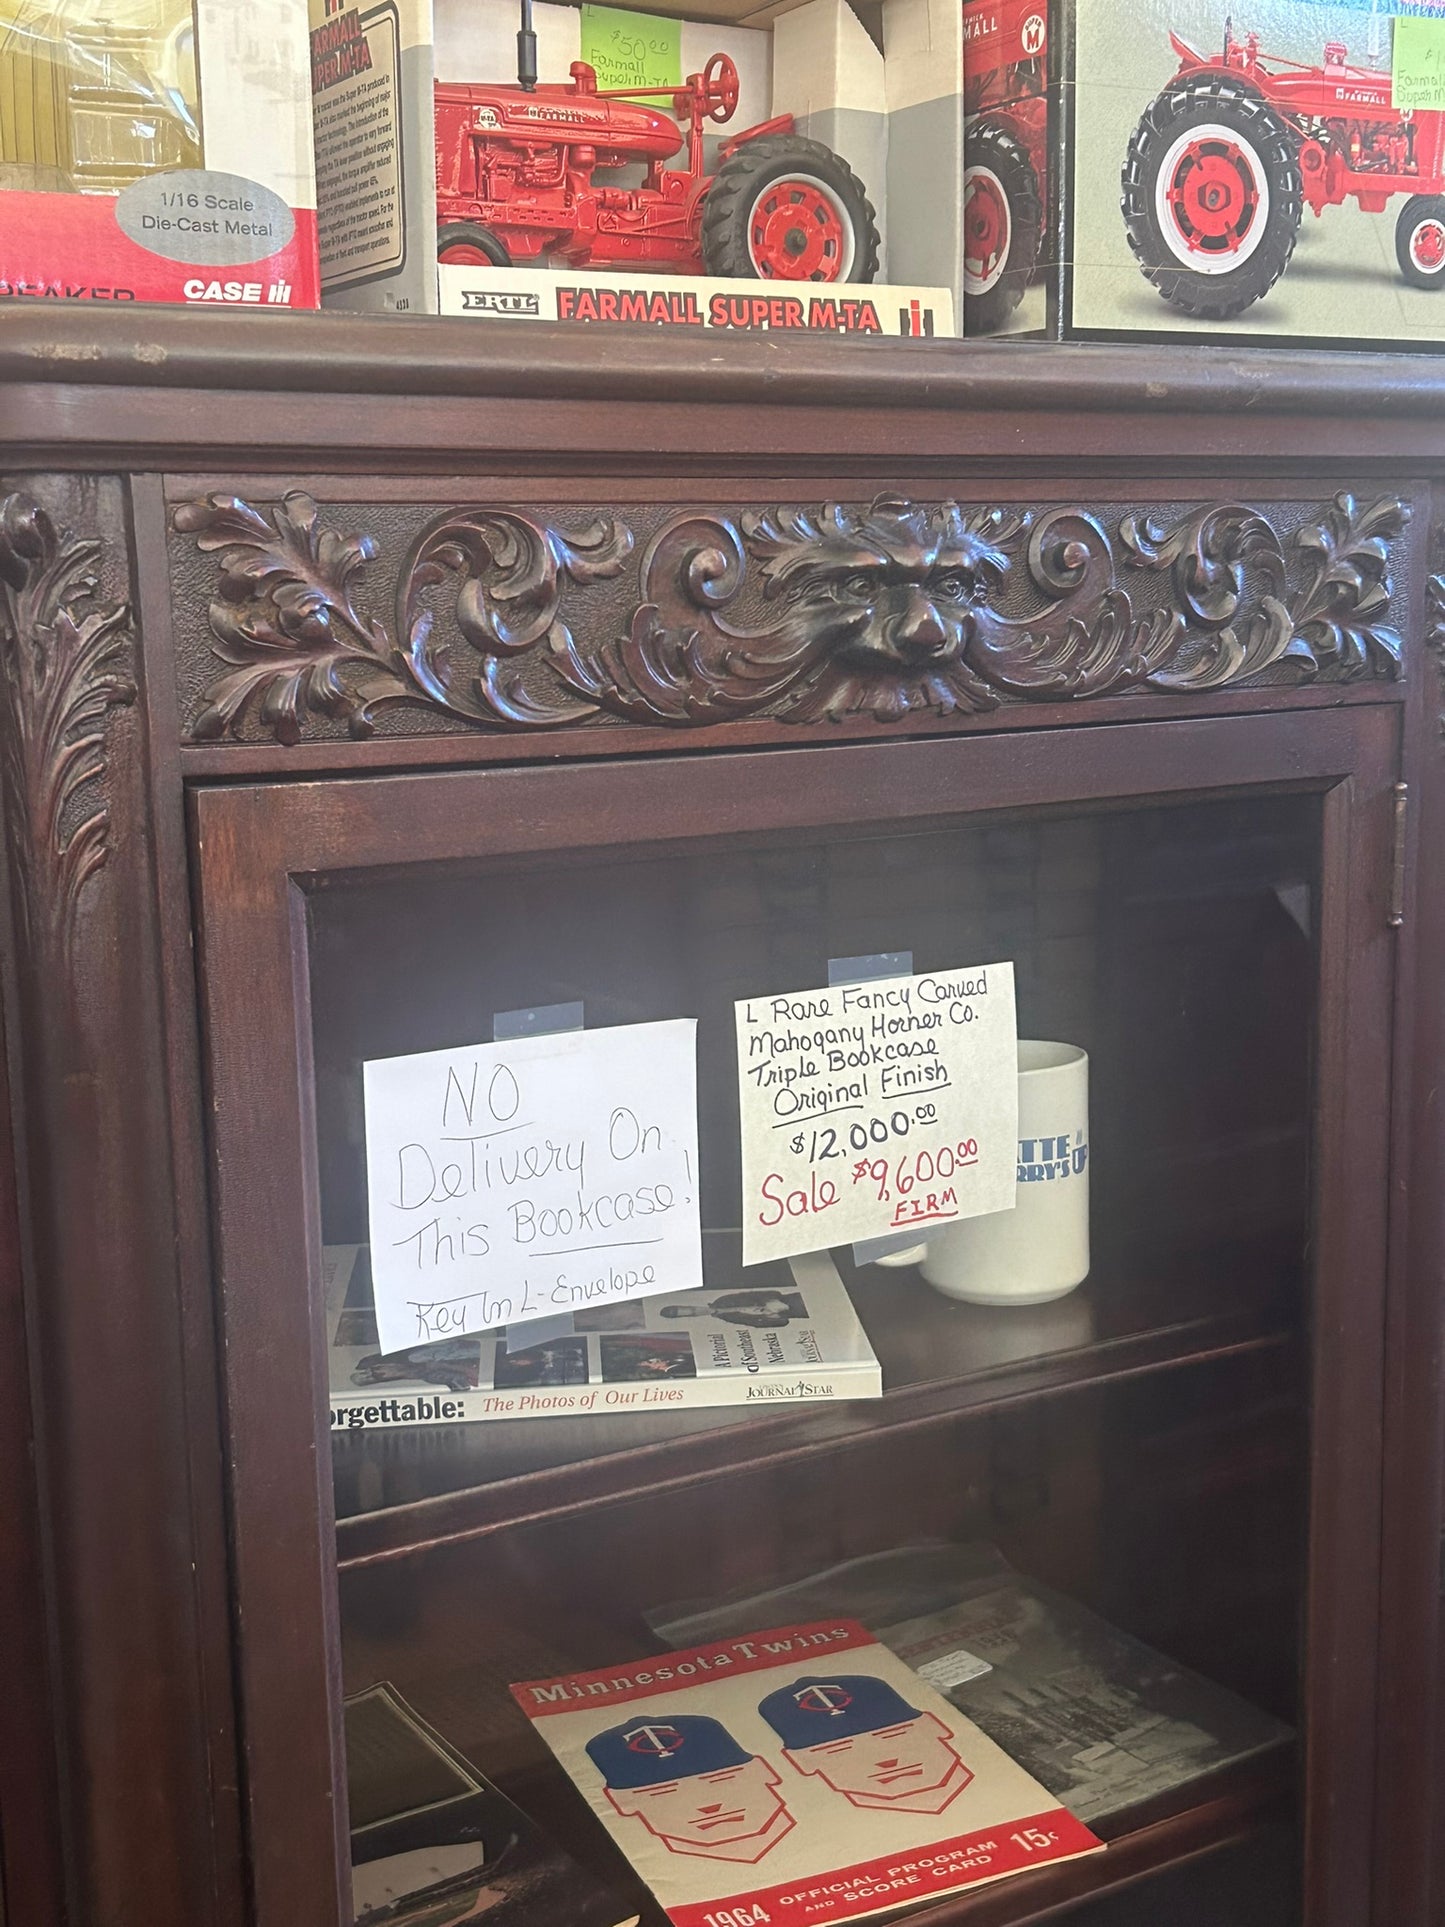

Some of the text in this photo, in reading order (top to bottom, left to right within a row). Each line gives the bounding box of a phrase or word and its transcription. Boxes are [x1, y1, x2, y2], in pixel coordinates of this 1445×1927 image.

[1026, 29, 1041, 51] M
[591, 48, 645, 74] Farmall
[1345, 92, 1386, 105] FARMALL
[161, 192, 255, 212] 1/16 Scale
[141, 214, 273, 237] Die-Cast Metal
[183, 279, 262, 303] CASE
[465, 293, 537, 312] ERTL
[558, 289, 702, 325] FARMALL
[711, 295, 804, 328] SUPER
[810, 301, 881, 332] M-TA
[746, 970, 988, 1024] L Rare Fancy Carved
[749, 1001, 979, 1059] Mahogany Horner Co.
[747, 1038, 940, 1088] Triple Bookcase
[442, 1061, 520, 1127] NO
[773, 1059, 949, 1117] Original Finish
[388, 1106, 662, 1210] Delivery On
[1016, 1133, 1070, 1163] TTE
[759, 1170, 841, 1227] Sale
[893, 1186, 959, 1221] FIRM
[392, 1216, 490, 1269] This
[414, 1301, 467, 1341] Key
[707, 1332, 731, 1363] Pictorial
[735, 1328, 759, 1362] Southeast
[762, 1331, 787, 1364] Nebraska
[483, 1397, 514, 1413] The
[518, 1392, 576, 1411] Photos
[579, 1389, 600, 1409] of
[604, 1388, 639, 1406] Our
[643, 1386, 685, 1402] Lives
[529, 1652, 733, 1704] Minnesota
[732, 1625, 850, 1661] Twins
[704, 1853, 993, 1927] 1964 AND SCORE CARD
[778, 1873, 882, 1906] OFFICIAL
[886, 1840, 998, 1878] PROGRAM
